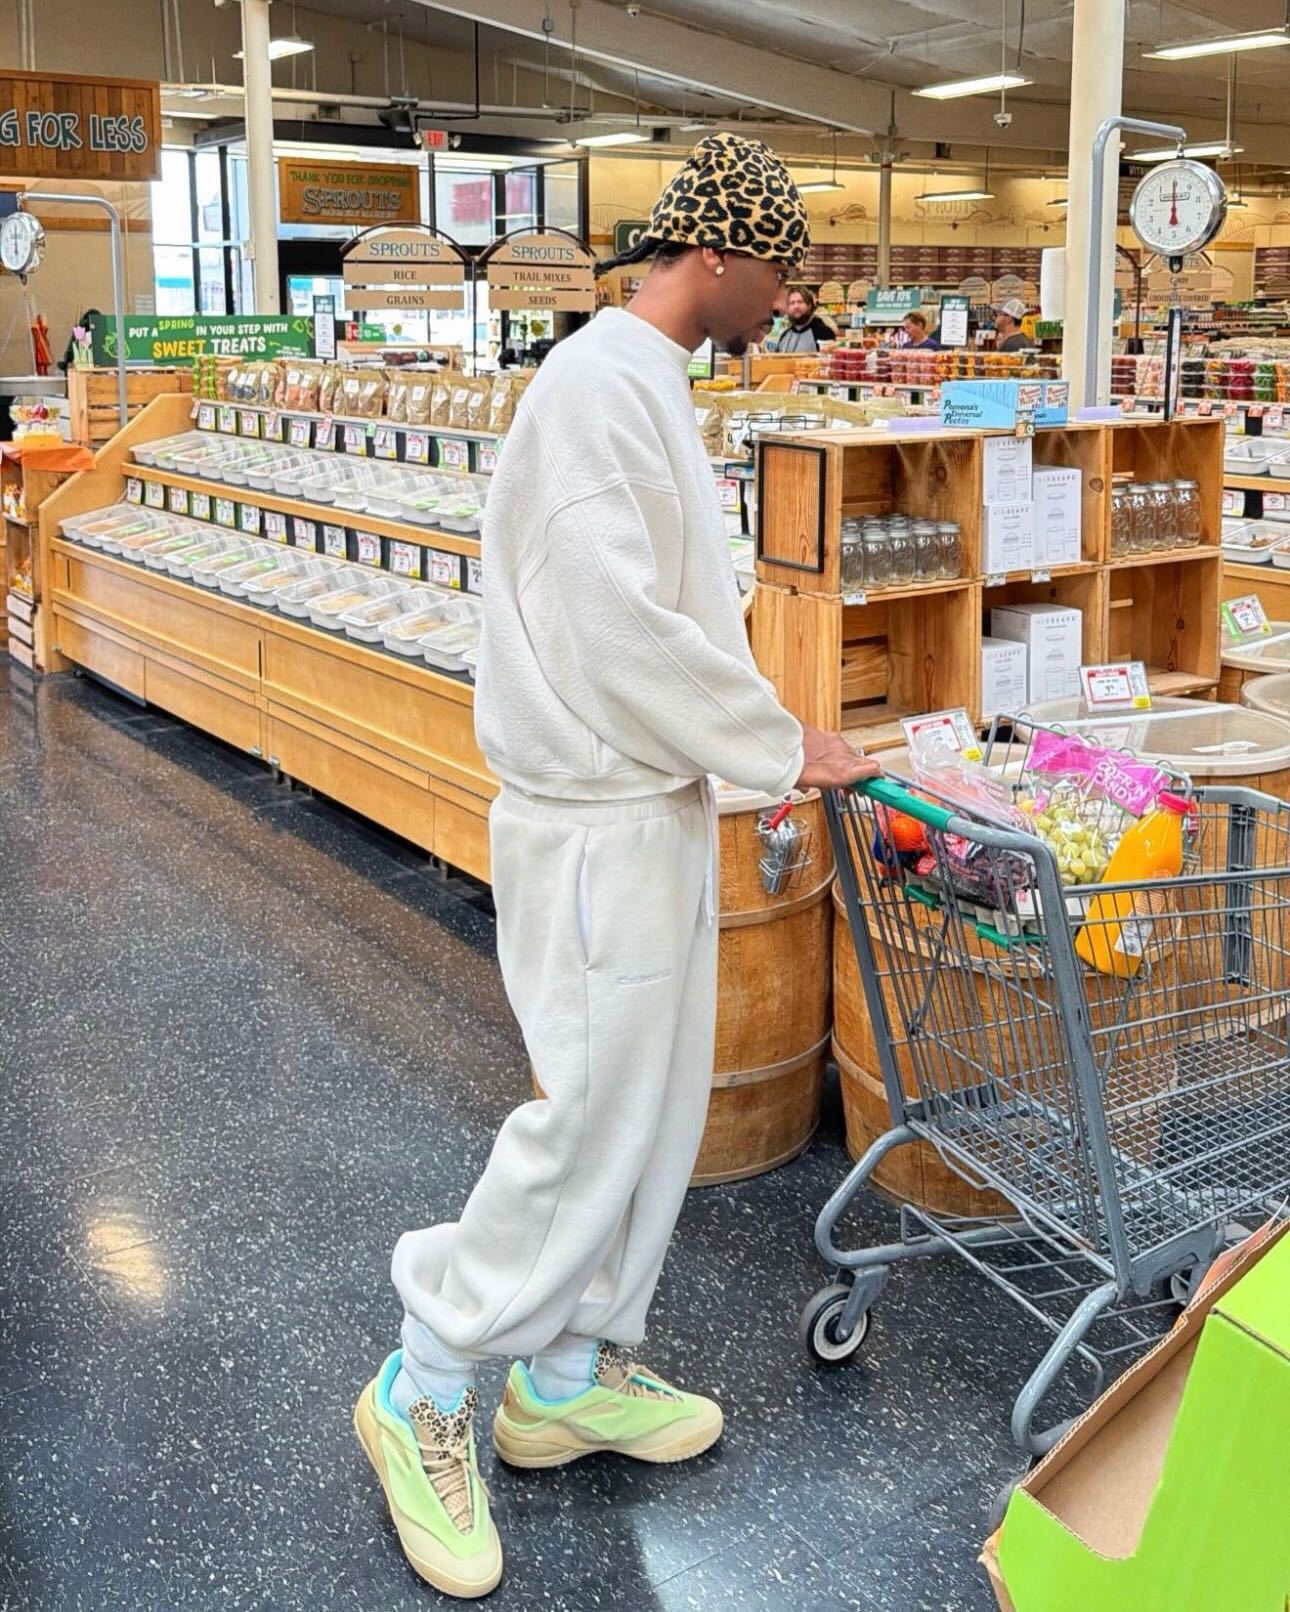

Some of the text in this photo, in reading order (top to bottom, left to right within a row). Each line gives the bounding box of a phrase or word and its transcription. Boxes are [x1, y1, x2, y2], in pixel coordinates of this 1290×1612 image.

[0, 109, 148, 154] G FOR LESS
[428, 131, 444, 146] EXIT
[290, 170, 321, 183] THANK
[323, 172, 345, 186] YOU
[346, 174, 365, 186] FOR
[303, 185, 401, 214] SPROUTS
[369, 242, 440, 257] SPROUTS
[511, 245, 575, 261] SPROUTS
[393, 270, 417, 280] RICE
[513, 271, 571, 283] TRAIL MIXES
[386, 295, 425, 305] GRAINS
[528, 296, 557, 306] SEEDS
[129, 318, 289, 338] PUT A SPRING IN YOUR STEP WITH
[152, 339, 206, 359] SWEET
[211, 336, 267, 355] TREATS
[943, 399, 979, 411] Pomona's
[943, 413, 969, 425] Pectin
[951, 410, 983, 419] Universal
